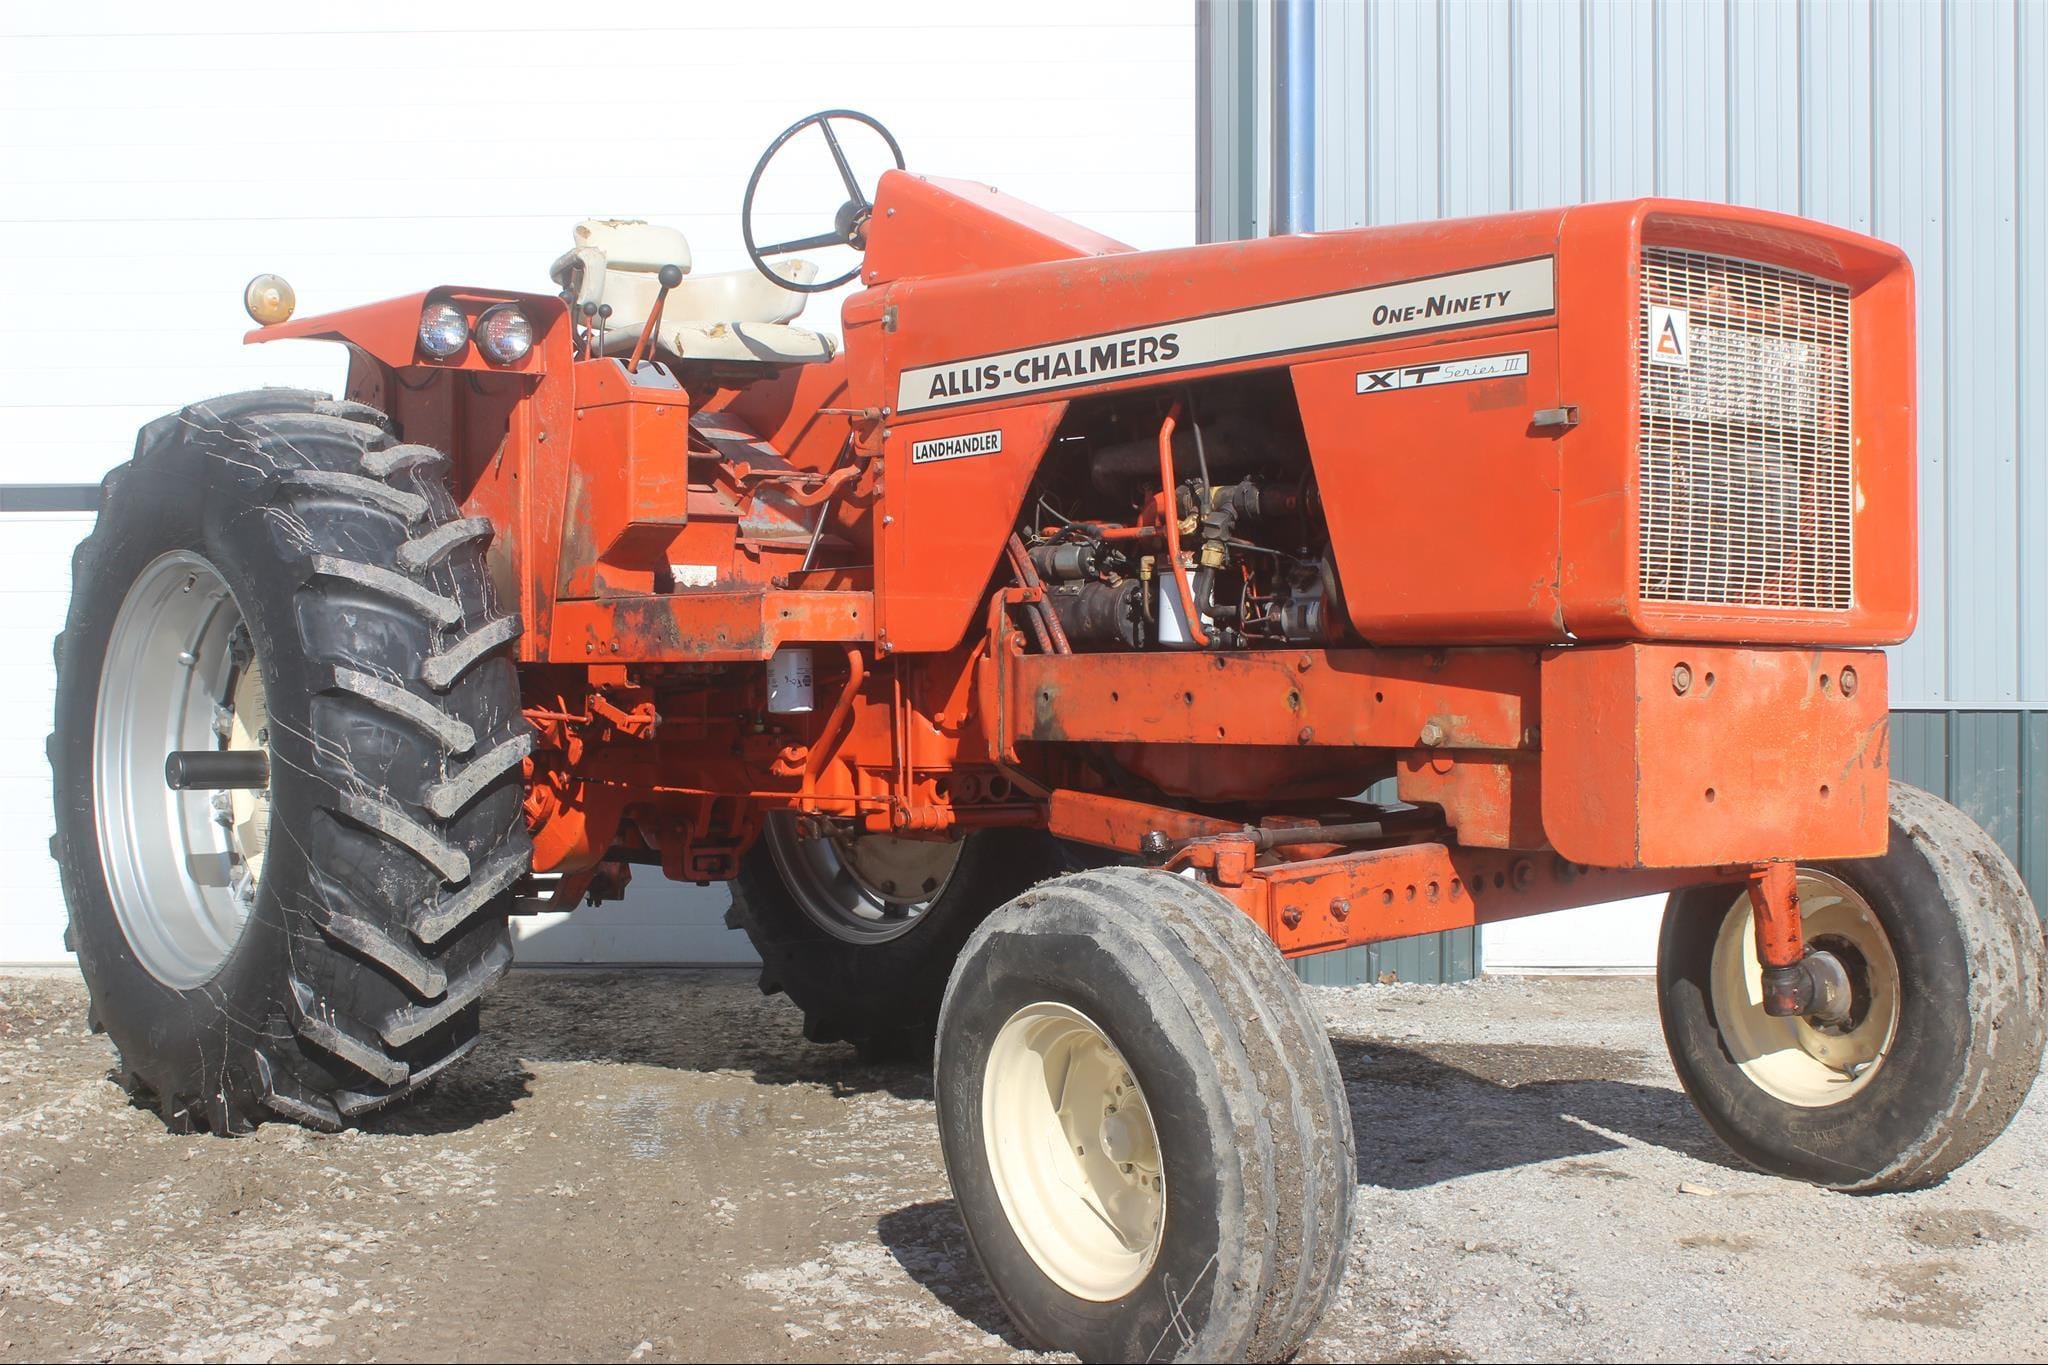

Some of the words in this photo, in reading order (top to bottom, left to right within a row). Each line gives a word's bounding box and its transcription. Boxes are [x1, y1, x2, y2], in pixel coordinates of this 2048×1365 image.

[928, 333, 1180, 399] ALLIS-CHALMERS
[1444, 363, 1500, 379] Series
[1503, 358, 1521, 372] III
[915, 433, 998, 460] LANDHANDLER
